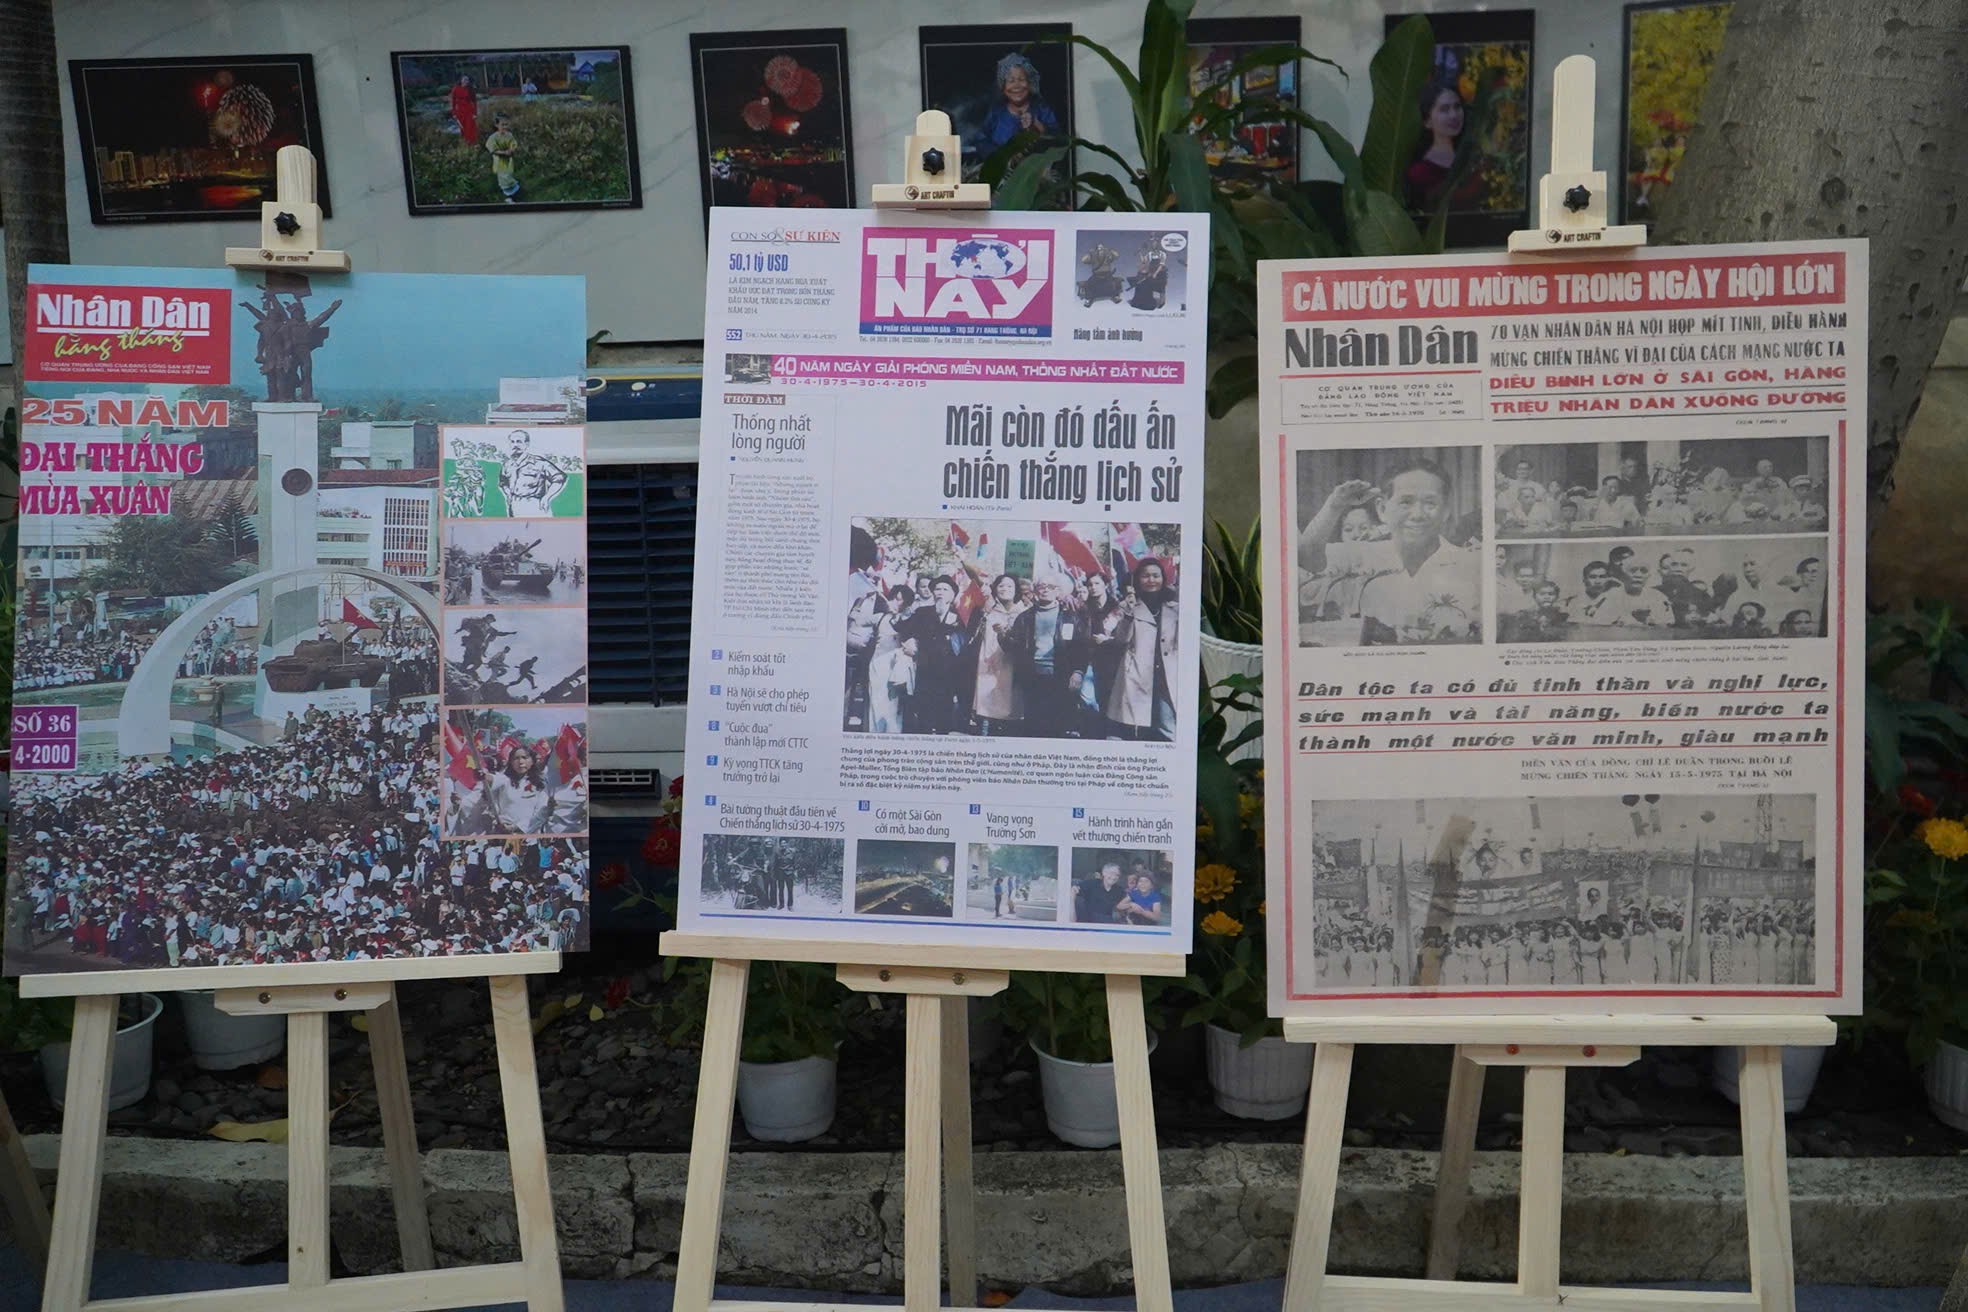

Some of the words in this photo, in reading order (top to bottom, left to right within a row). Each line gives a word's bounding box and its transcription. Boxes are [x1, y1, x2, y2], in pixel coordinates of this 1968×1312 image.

[731, 231, 757, 240] CON
[767, 254, 788, 272] USD
[867, 233, 1050, 280] THỜI
[1293, 276, 1327, 312] CẢ
[1333, 275, 1407, 311] NƯỚC
[1414, 277, 1459, 308] VUI
[1468, 271, 1548, 307] MỪNG
[1555, 271, 1643, 304] TRONG
[1648, 264, 1722, 301] NGÀY
[1728, 262, 1775, 301] HỘI
[1783, 259, 1835, 296] LỚN
[875, 278, 1048, 319] NAY
[37, 293, 131, 327] Nhân
[141, 295, 210, 329] Dân
[727, 330, 742, 340] 552
[1545, 319, 1581, 338] NHÂN
[1584, 319, 1612, 337] DÂN
[1617, 317, 1634, 336] HÀ
[1640, 317, 1663, 338] NỘI
[118, 327, 184, 352] tháng
[1285, 327, 1390, 368] Nhân
[1398, 325, 1478, 366] Dân
[1534, 347, 1573, 366] CHIẾN
[1700, 343, 1737, 361] CÁCH
[1784, 339, 1823, 358] NƯỚC
[1828, 341, 1845, 357] TA
[774, 356, 797, 375] 40
[800, 360, 830, 372] NĂM
[834, 360, 871, 373] NGÀY
[875, 359, 899, 373] GIẢI
[903, 360, 947, 374] PHÓNG
[950, 359, 981, 375] MIỀN
[985, 365, 1018, 377] NAM,
[1022, 361, 1066, 377] THỐNG
[1070, 361, 1106, 377] NHẤT
[1110, 362, 1138, 378] ĐẤT
[1142, 363, 1178, 378] NƯỚC
[22, 399, 87, 425] 25
[97, 393, 229, 427] NĂM
[732, 412, 775, 435] Thống
[779, 413, 812, 432] nhất
[945, 403, 993, 447] Mãi
[1001, 404, 1045, 448] còn
[1054, 404, 1084, 449] đó
[1093, 399, 1137, 449] dấu
[1146, 399, 1176, 450] ấn
[87, 432, 204, 474] THẮNG
[732, 432, 762, 454] lòng
[766, 434, 806, 454] người
[943, 448, 1010, 499] chiến
[1019, 450, 1087, 504] thắng
[1096, 459, 1141, 511] lịch
[1151, 456, 1183, 502] sử
[88, 479, 171, 515] XUÂN
[1298, 682, 1343, 697] Dân
[1358, 680, 1396, 698] tộc
[1409, 680, 1434, 695] ta
[1447, 679, 1476, 694] có
[1487, 678, 1518, 694] đủ
[1533, 676, 1582, 693] tinh
[1595, 675, 1650, 691] thần
[1666, 675, 1694, 690] và
[1707, 674, 1763, 693] nghị
[1778, 674, 1829, 691] lực,
[14, 711, 42, 733] SỐ
[48, 715, 71, 733] 36
[1298, 709, 1345, 723] sức
[1361, 706, 1432, 724] mạnh
[1449, 705, 1477, 721] và
[1495, 705, 1531, 720] tài
[1548, 704, 1620, 721] năng,
[1641, 703, 1700, 717] biến
[1718, 701, 1784, 716] nước
[1803, 701, 1829, 715] ta
[1298, 734, 1372, 751] thành
[1387, 733, 1435, 751] một
[1452, 732, 1516, 748] nước
[1532, 731, 1577, 747] văn
[1592, 730, 1663, 747] minh,
[1680, 729, 1735, 747] giàu
[1752, 728, 1829, 746] mạnh
[15, 744, 70, 764] 4-2000
[799, 820, 845, 833] 30-4-1975
[986, 812, 1008, 826] Vang
